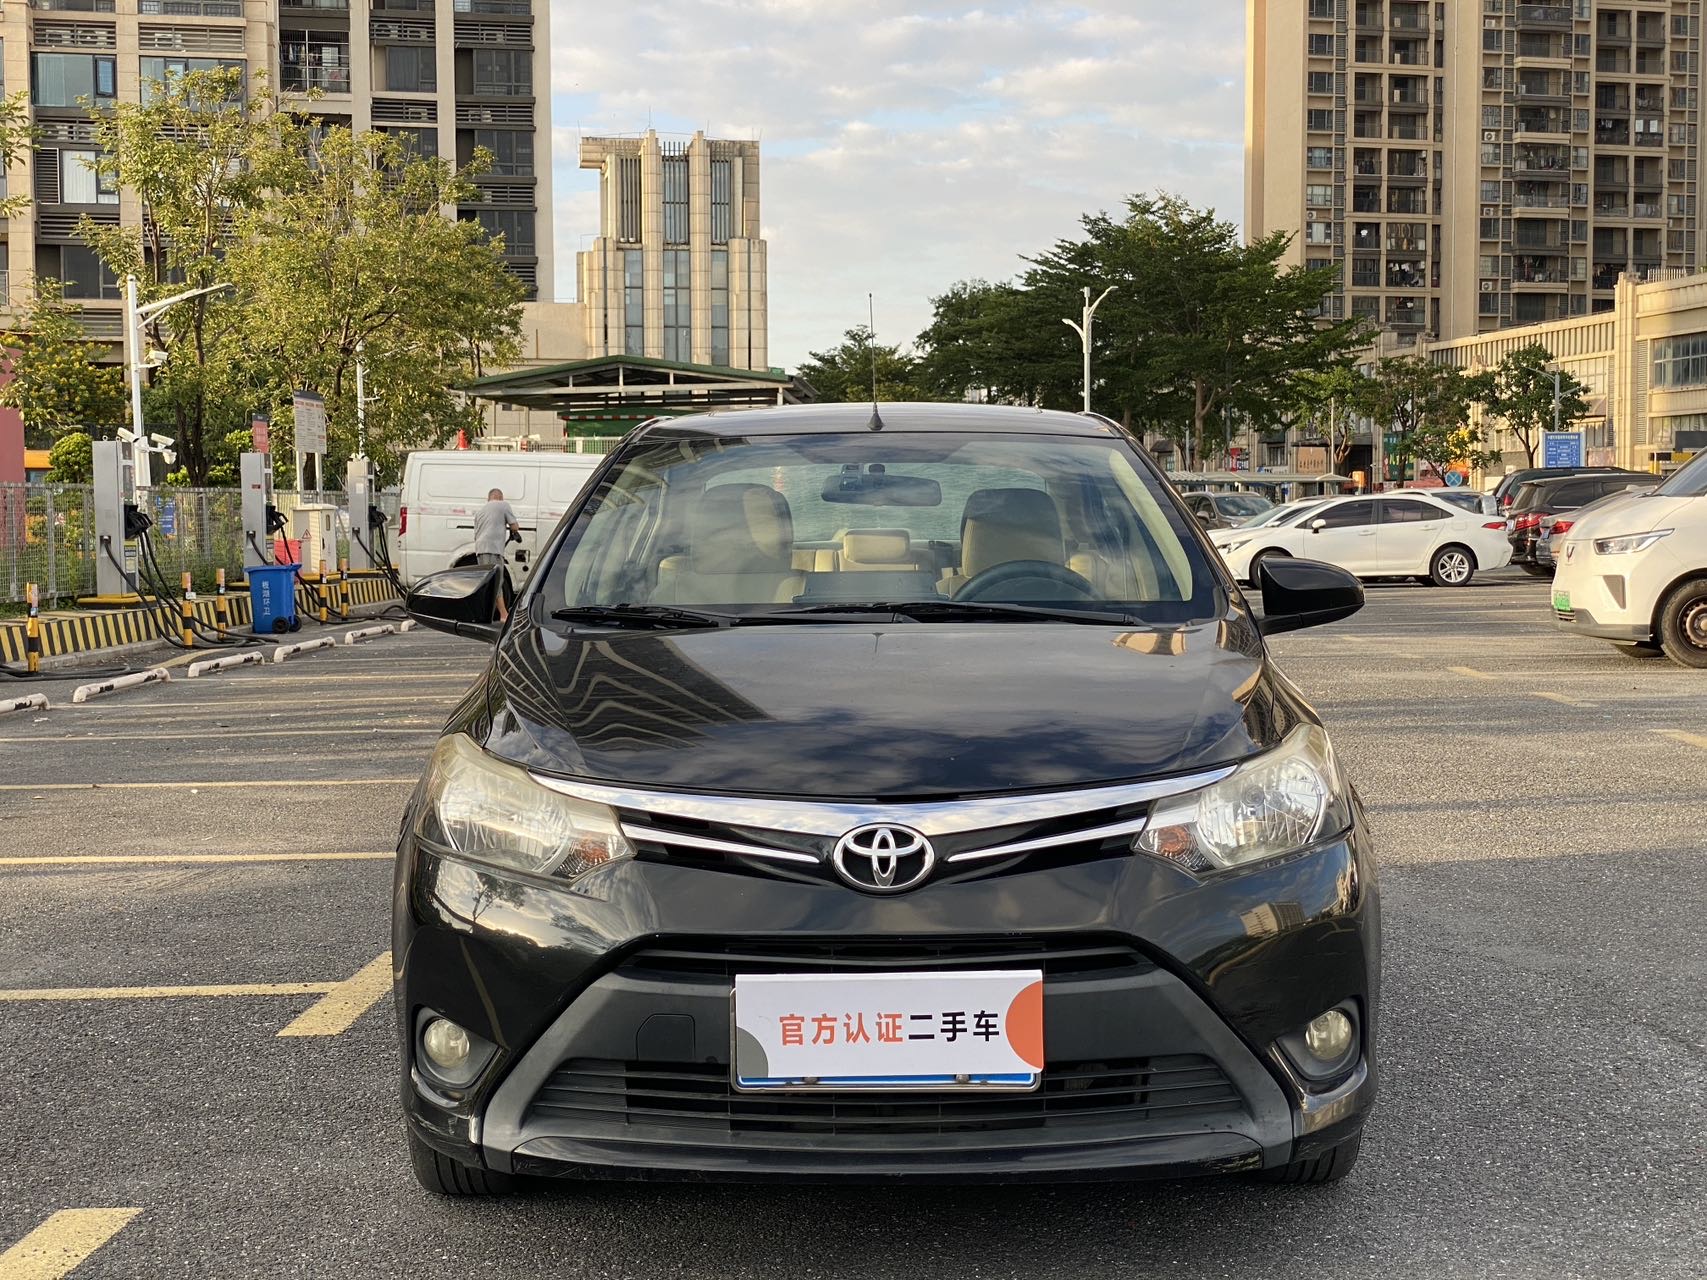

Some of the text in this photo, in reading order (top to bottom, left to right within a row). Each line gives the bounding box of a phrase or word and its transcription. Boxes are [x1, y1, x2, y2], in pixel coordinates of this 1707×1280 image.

[779, 1010, 1000, 1046] 官方认证二手车
